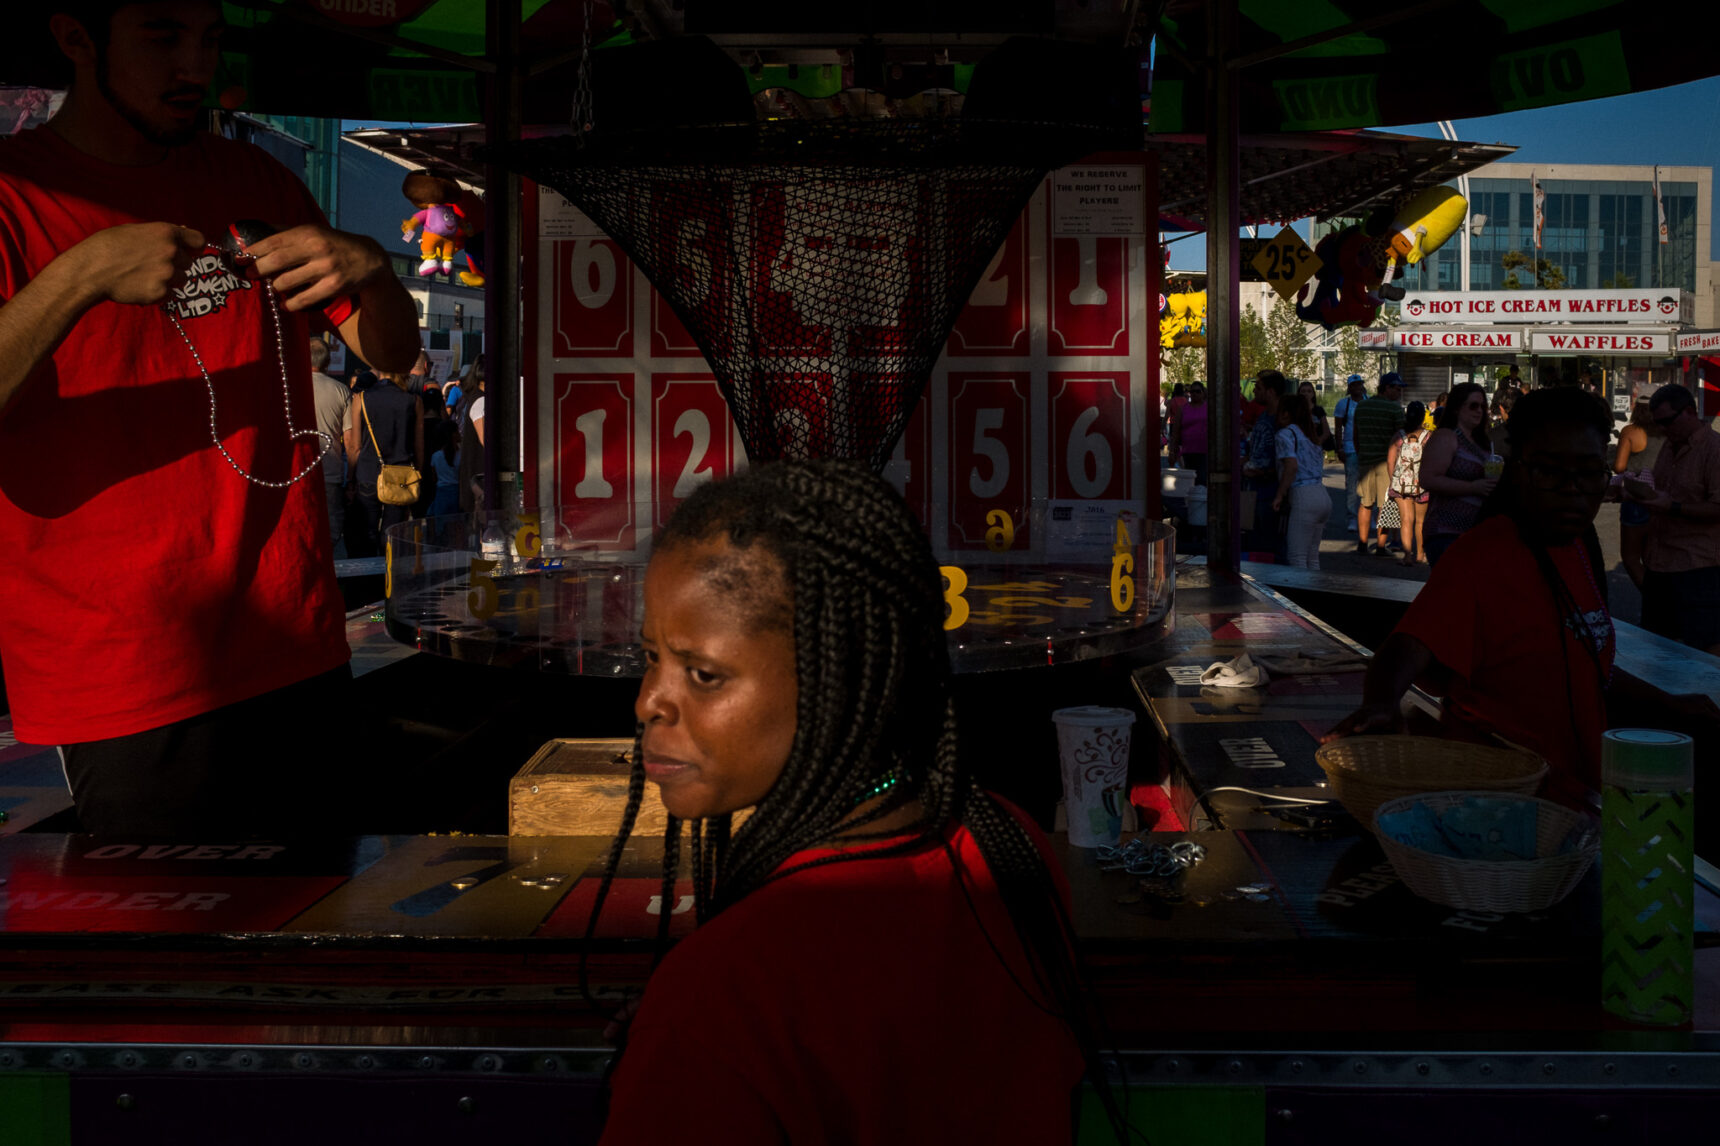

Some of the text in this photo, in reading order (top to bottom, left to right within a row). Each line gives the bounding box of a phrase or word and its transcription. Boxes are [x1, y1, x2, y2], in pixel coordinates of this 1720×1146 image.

[1057, 184, 1142, 192] THE RIGHT TO LIMIT
[1079, 197, 1119, 205] PLAYERS
[177, 297, 213, 319] LTD
[1429, 299, 1651, 314] HOT ICE CREAM WAFFLES
[1400, 333, 1512, 347] ICE CREAM
[1548, 335, 1654, 350] WAFFLES
[1680, 335, 1701, 348] FRESH
[575, 408, 614, 499] 1
[672, 408, 713, 499] 2
[968, 407, 1011, 499] 5
[1066, 406, 1114, 499] 6
[467, 557, 500, 620] 5
[1110, 551, 1135, 613] 6
[1217, 737, 1287, 769] OVER
[83, 844, 288, 860] OVER
[216, 985, 340, 1000] ASK
